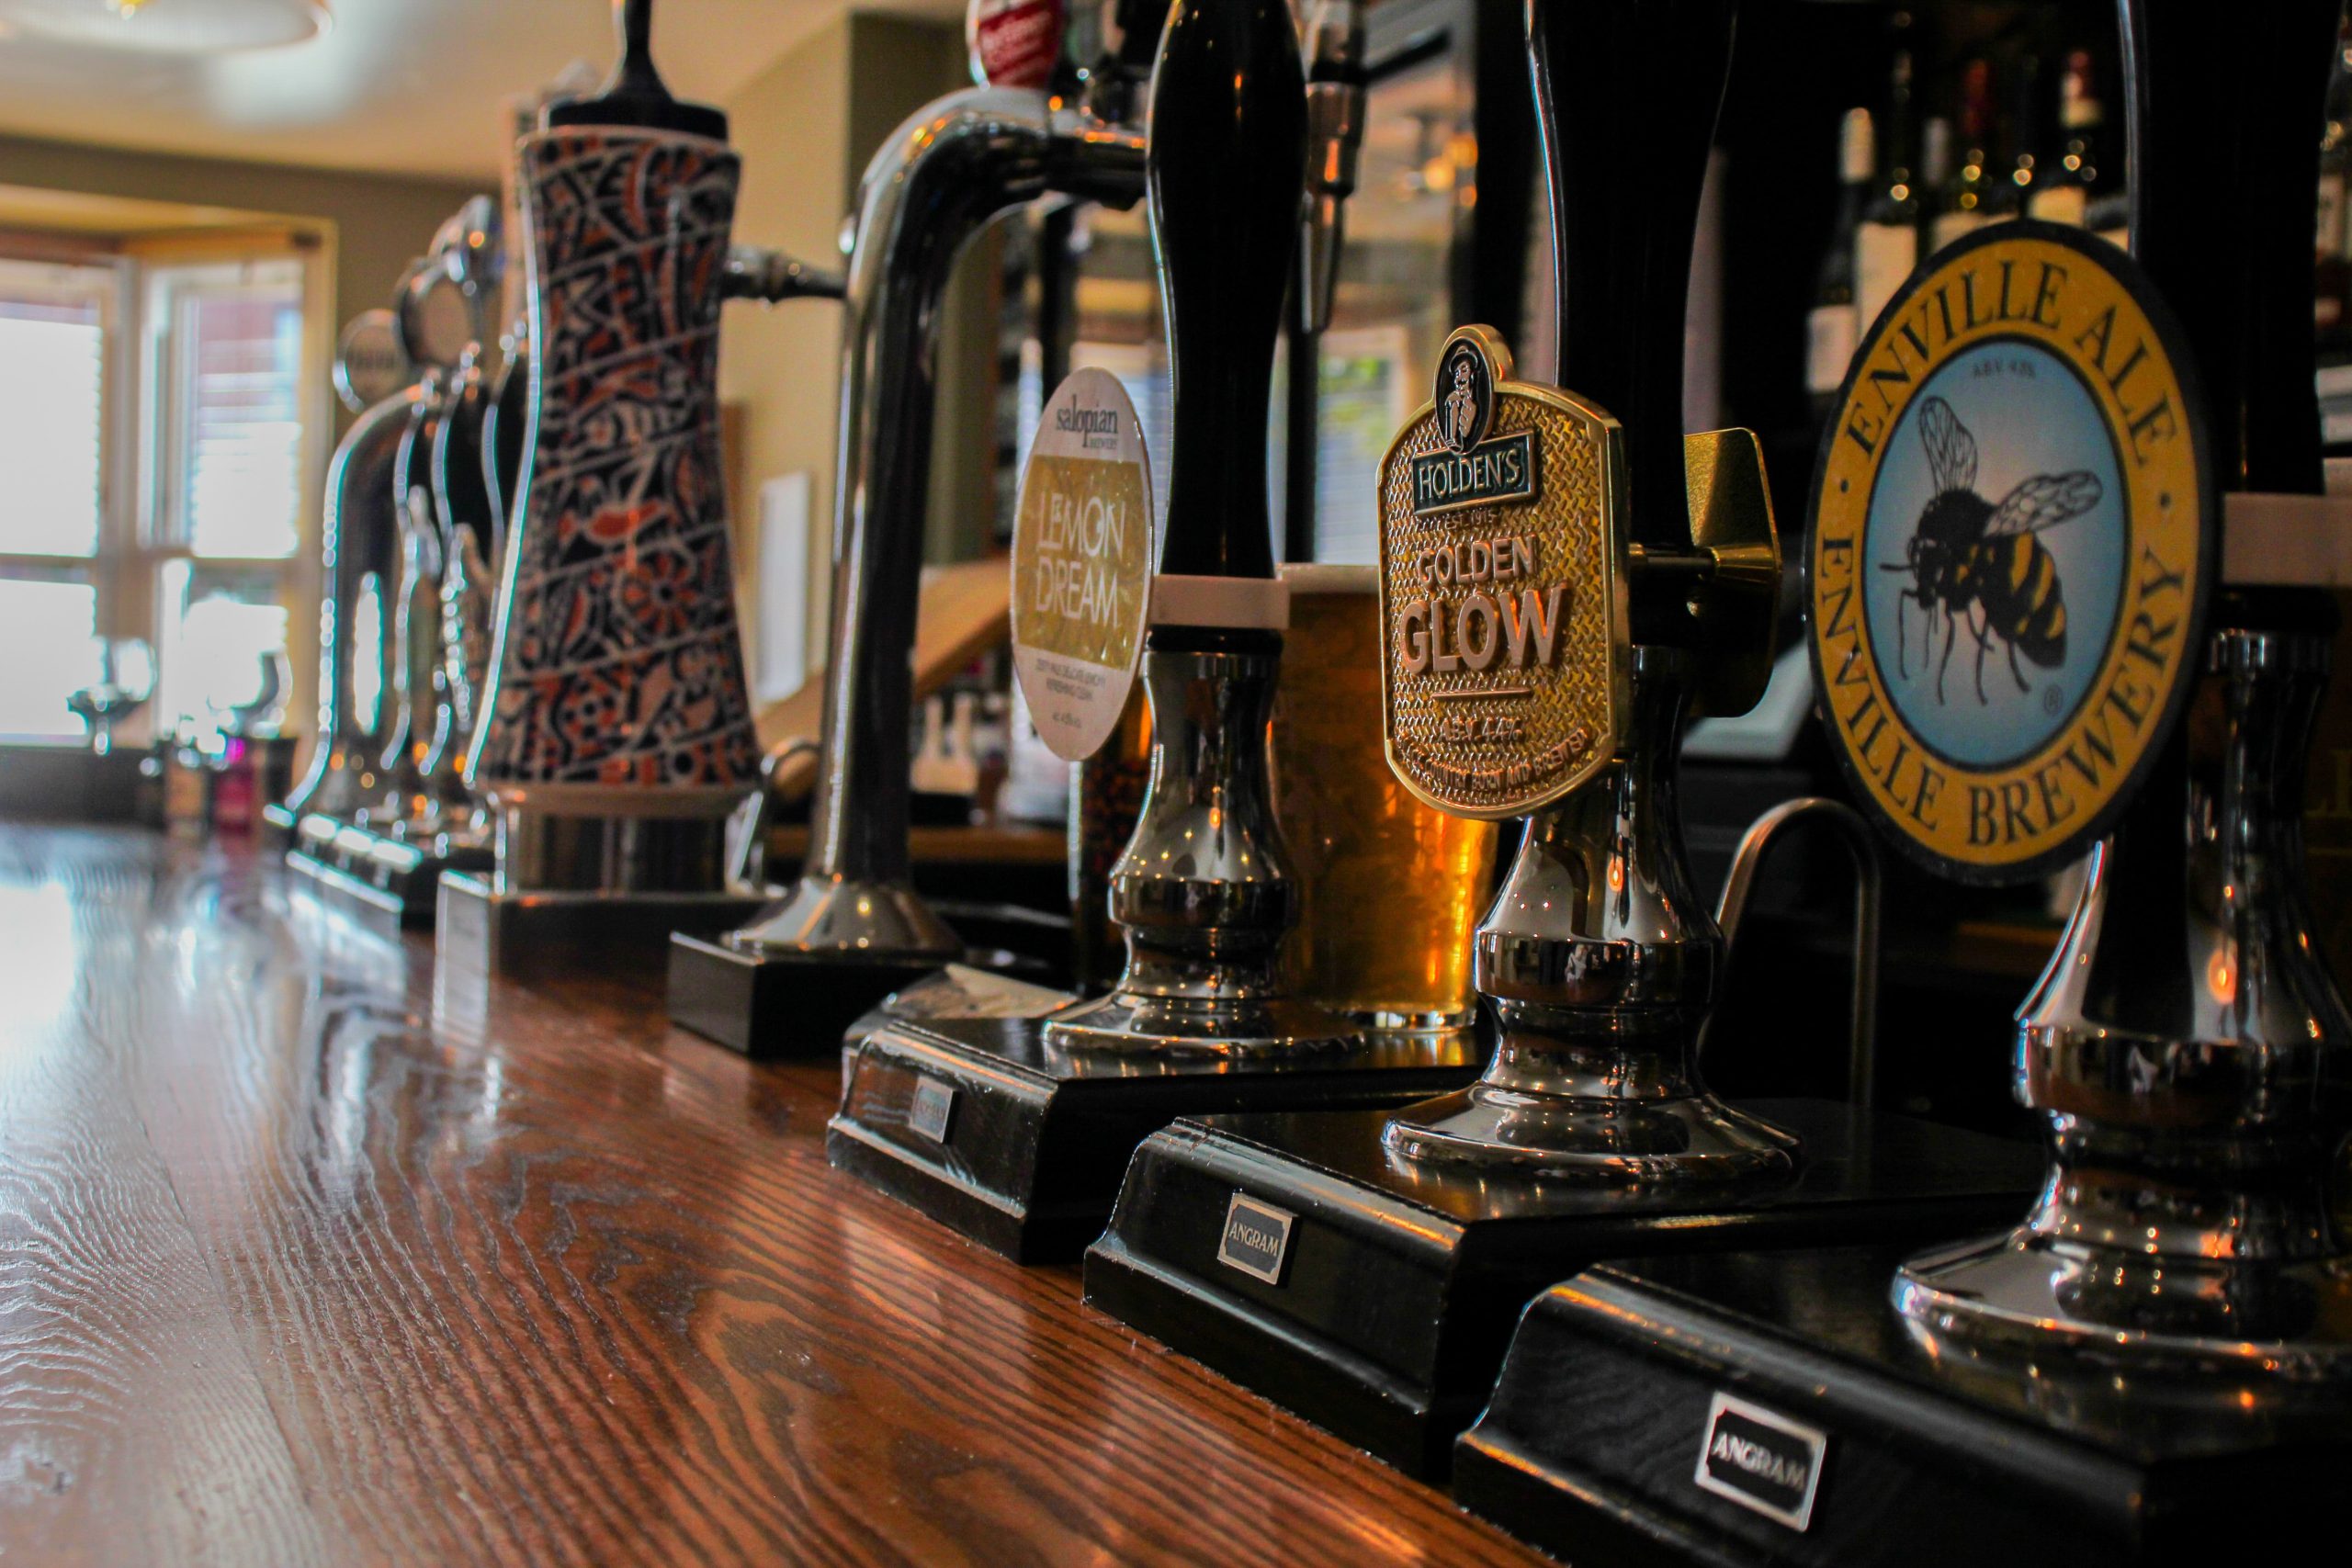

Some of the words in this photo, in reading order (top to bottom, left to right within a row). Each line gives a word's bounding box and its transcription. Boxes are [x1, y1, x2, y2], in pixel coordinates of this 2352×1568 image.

[1846, 261, 2068, 457] ENVILLE
[2073, 304, 2180, 468] ALE
[1057, 394, 1118, 447] salopian
[1419, 447, 1521, 501] HOLDEN'S
[1036, 491, 1127, 562] LEMON
[1416, 533, 1537, 587] GOLDEN
[1036, 557, 1119, 630] DREAM
[1399, 581, 1569, 674] GLOW
[1821, 536, 1946, 832] ENVILLE
[1966, 546, 2186, 847] BREWERY
[1228, 1222, 1280, 1257] ANGRAM
[1710, 1430, 1807, 1493] ANGRAM
